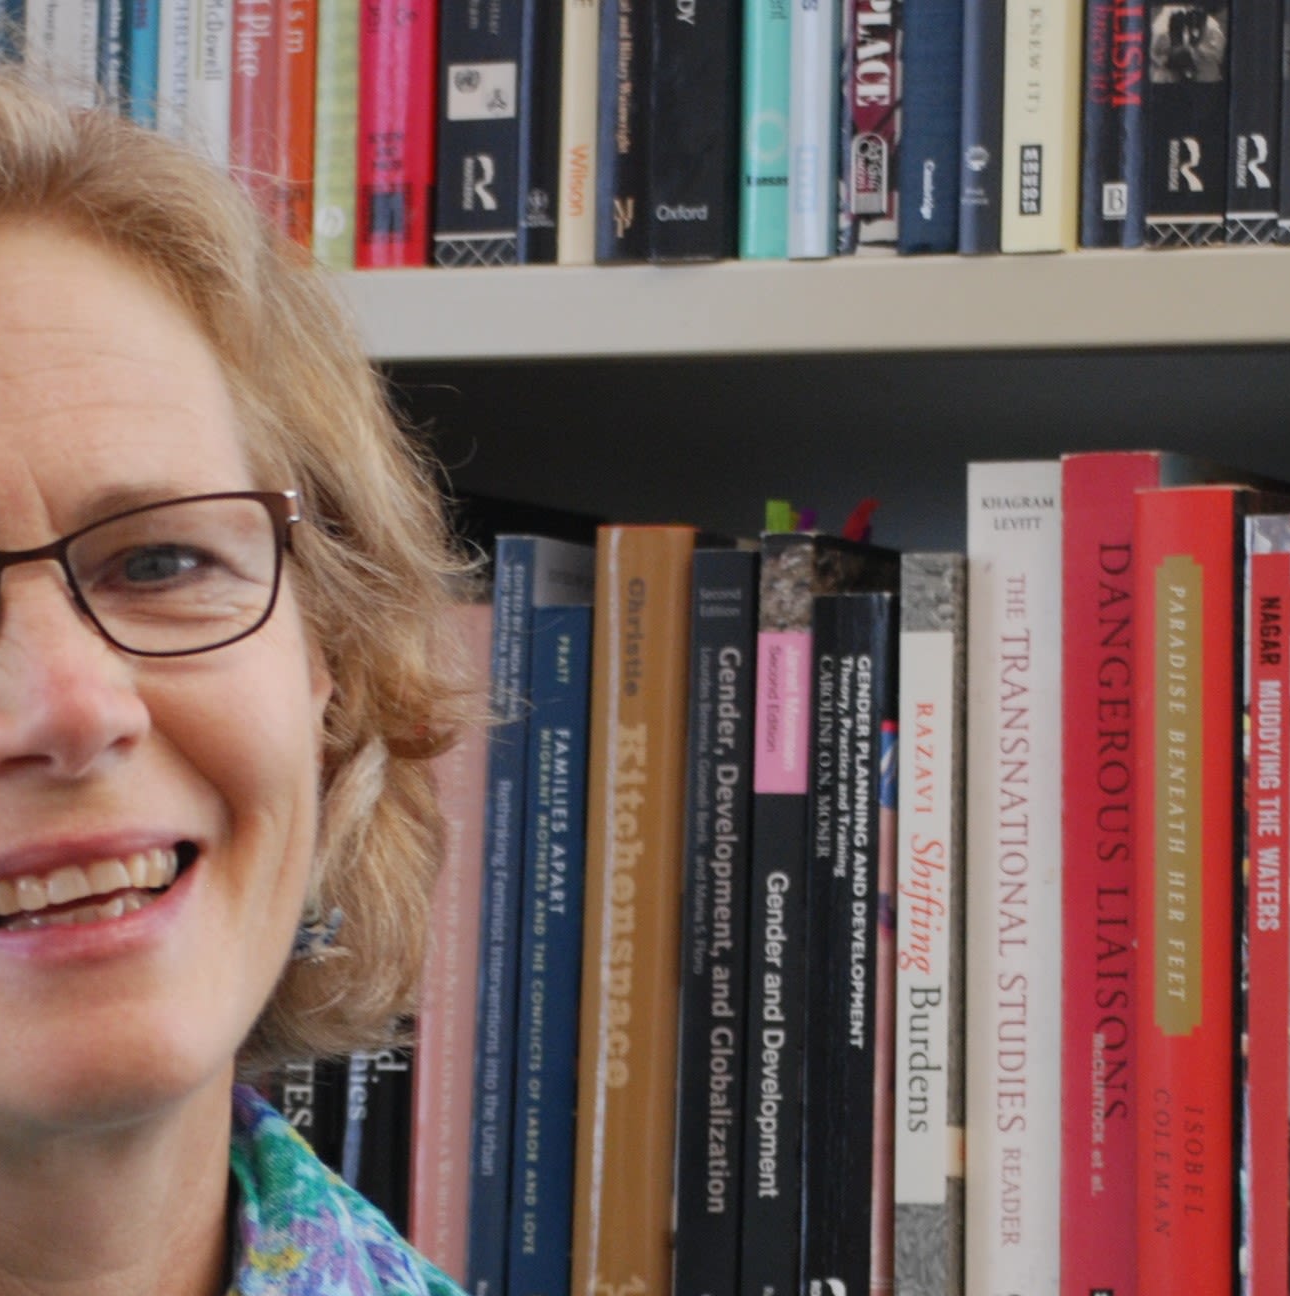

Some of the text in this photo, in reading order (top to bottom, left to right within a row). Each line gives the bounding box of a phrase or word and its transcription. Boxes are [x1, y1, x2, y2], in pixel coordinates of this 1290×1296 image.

[567, 144, 588, 218] Wilson
[656, 203, 708, 222] Oxford
[554, 634, 570, 684] PRATT
[622, 577, 648, 697] Christie
[1165, 584, 1187, 1002] PARADISE BENEATH HER FEET
[1255, 595, 1282, 931] NAGAR MUDDYING THE WATERS
[547, 729, 572, 916] FAMILIES APART
[603, 721, 648, 1089] Kitchenspace
[706, 646, 741, 1212] Gender, Development, and Globalization
[847, 656, 872, 1048] GENDER PLANNING AND DEVELOPMENT
[898, 704, 944, 1134] RAZAVI Shifting Burdens
[998, 574, 1031, 1246] THE TRANSNATIONAL STUDIES READER
[1093, 543, 1133, 1121] DANGEROUS LIAISONS
[757, 873, 788, 1198] Gender and Development
[1151, 1088, 1171, 1238] COLEMAN
[1183, 1105, 1205, 1218] ISOBEL
